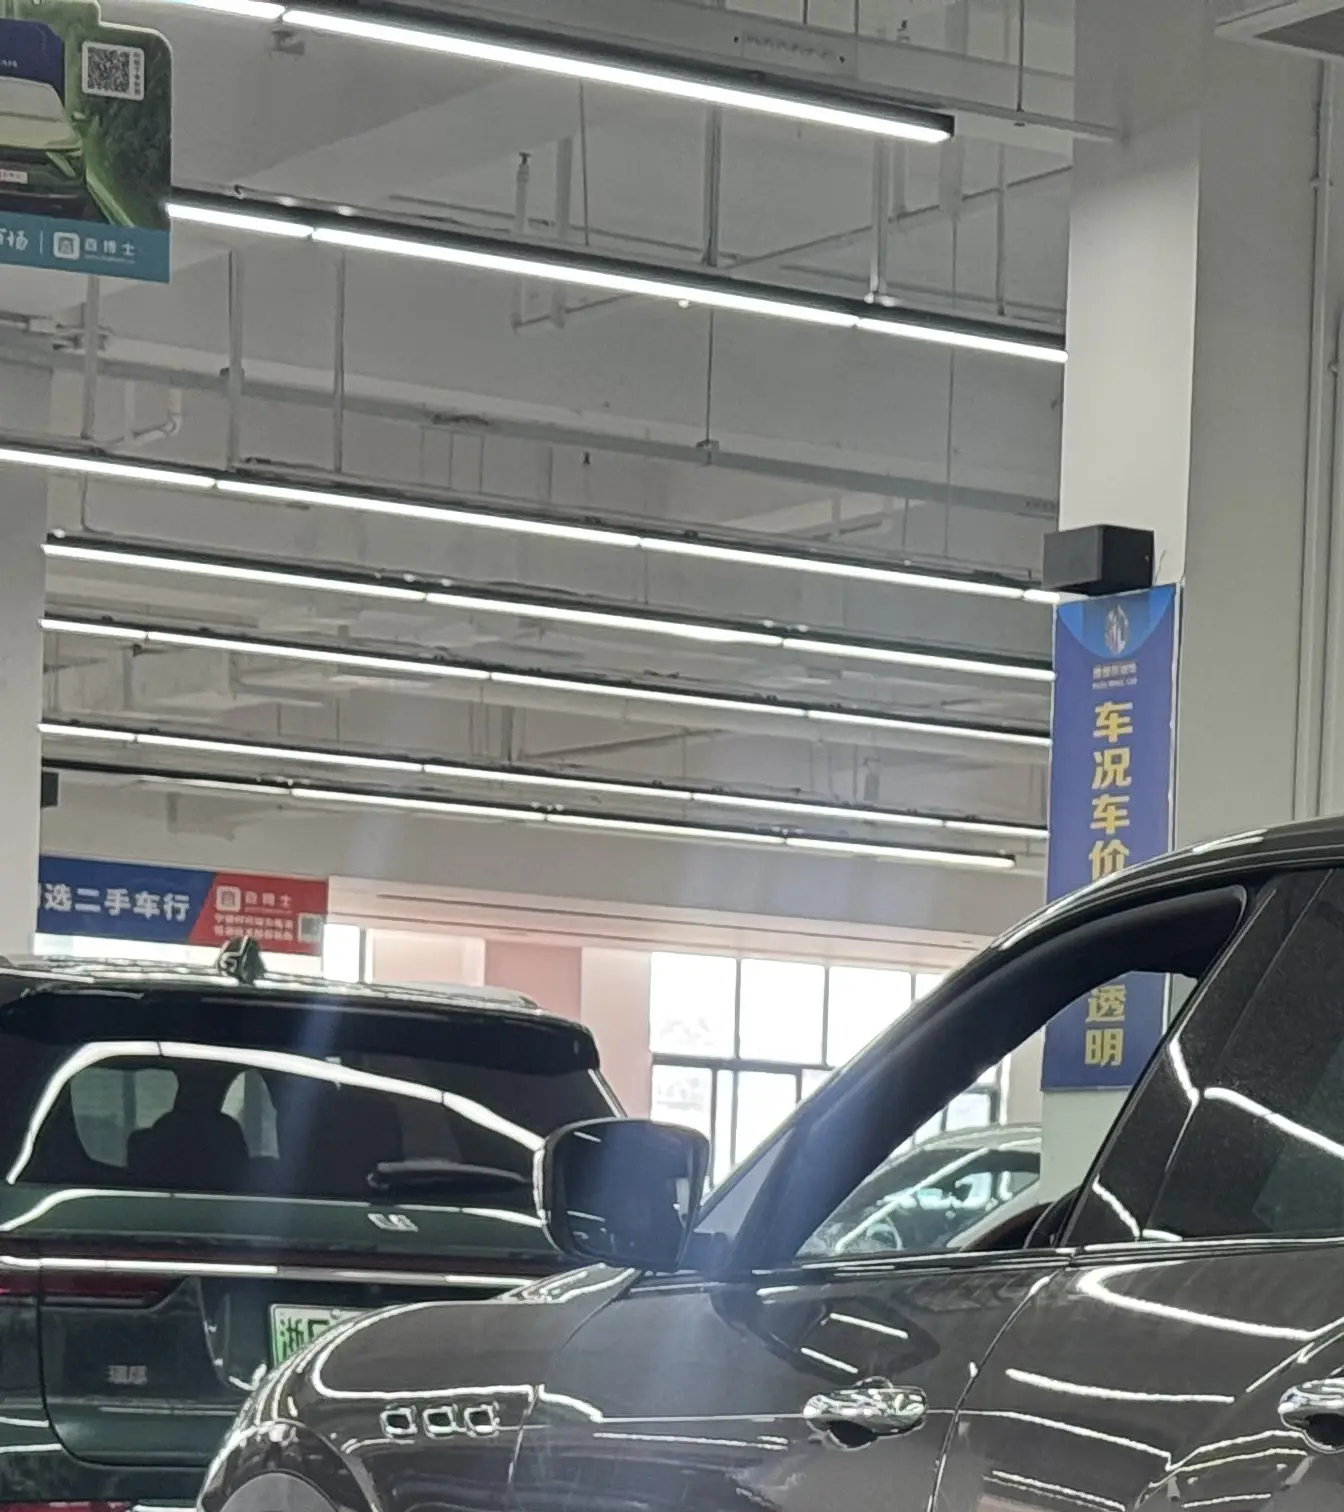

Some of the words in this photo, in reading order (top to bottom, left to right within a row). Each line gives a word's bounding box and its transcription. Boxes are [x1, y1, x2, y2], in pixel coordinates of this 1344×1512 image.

[37, 883, 190, 921] 选二手车行
